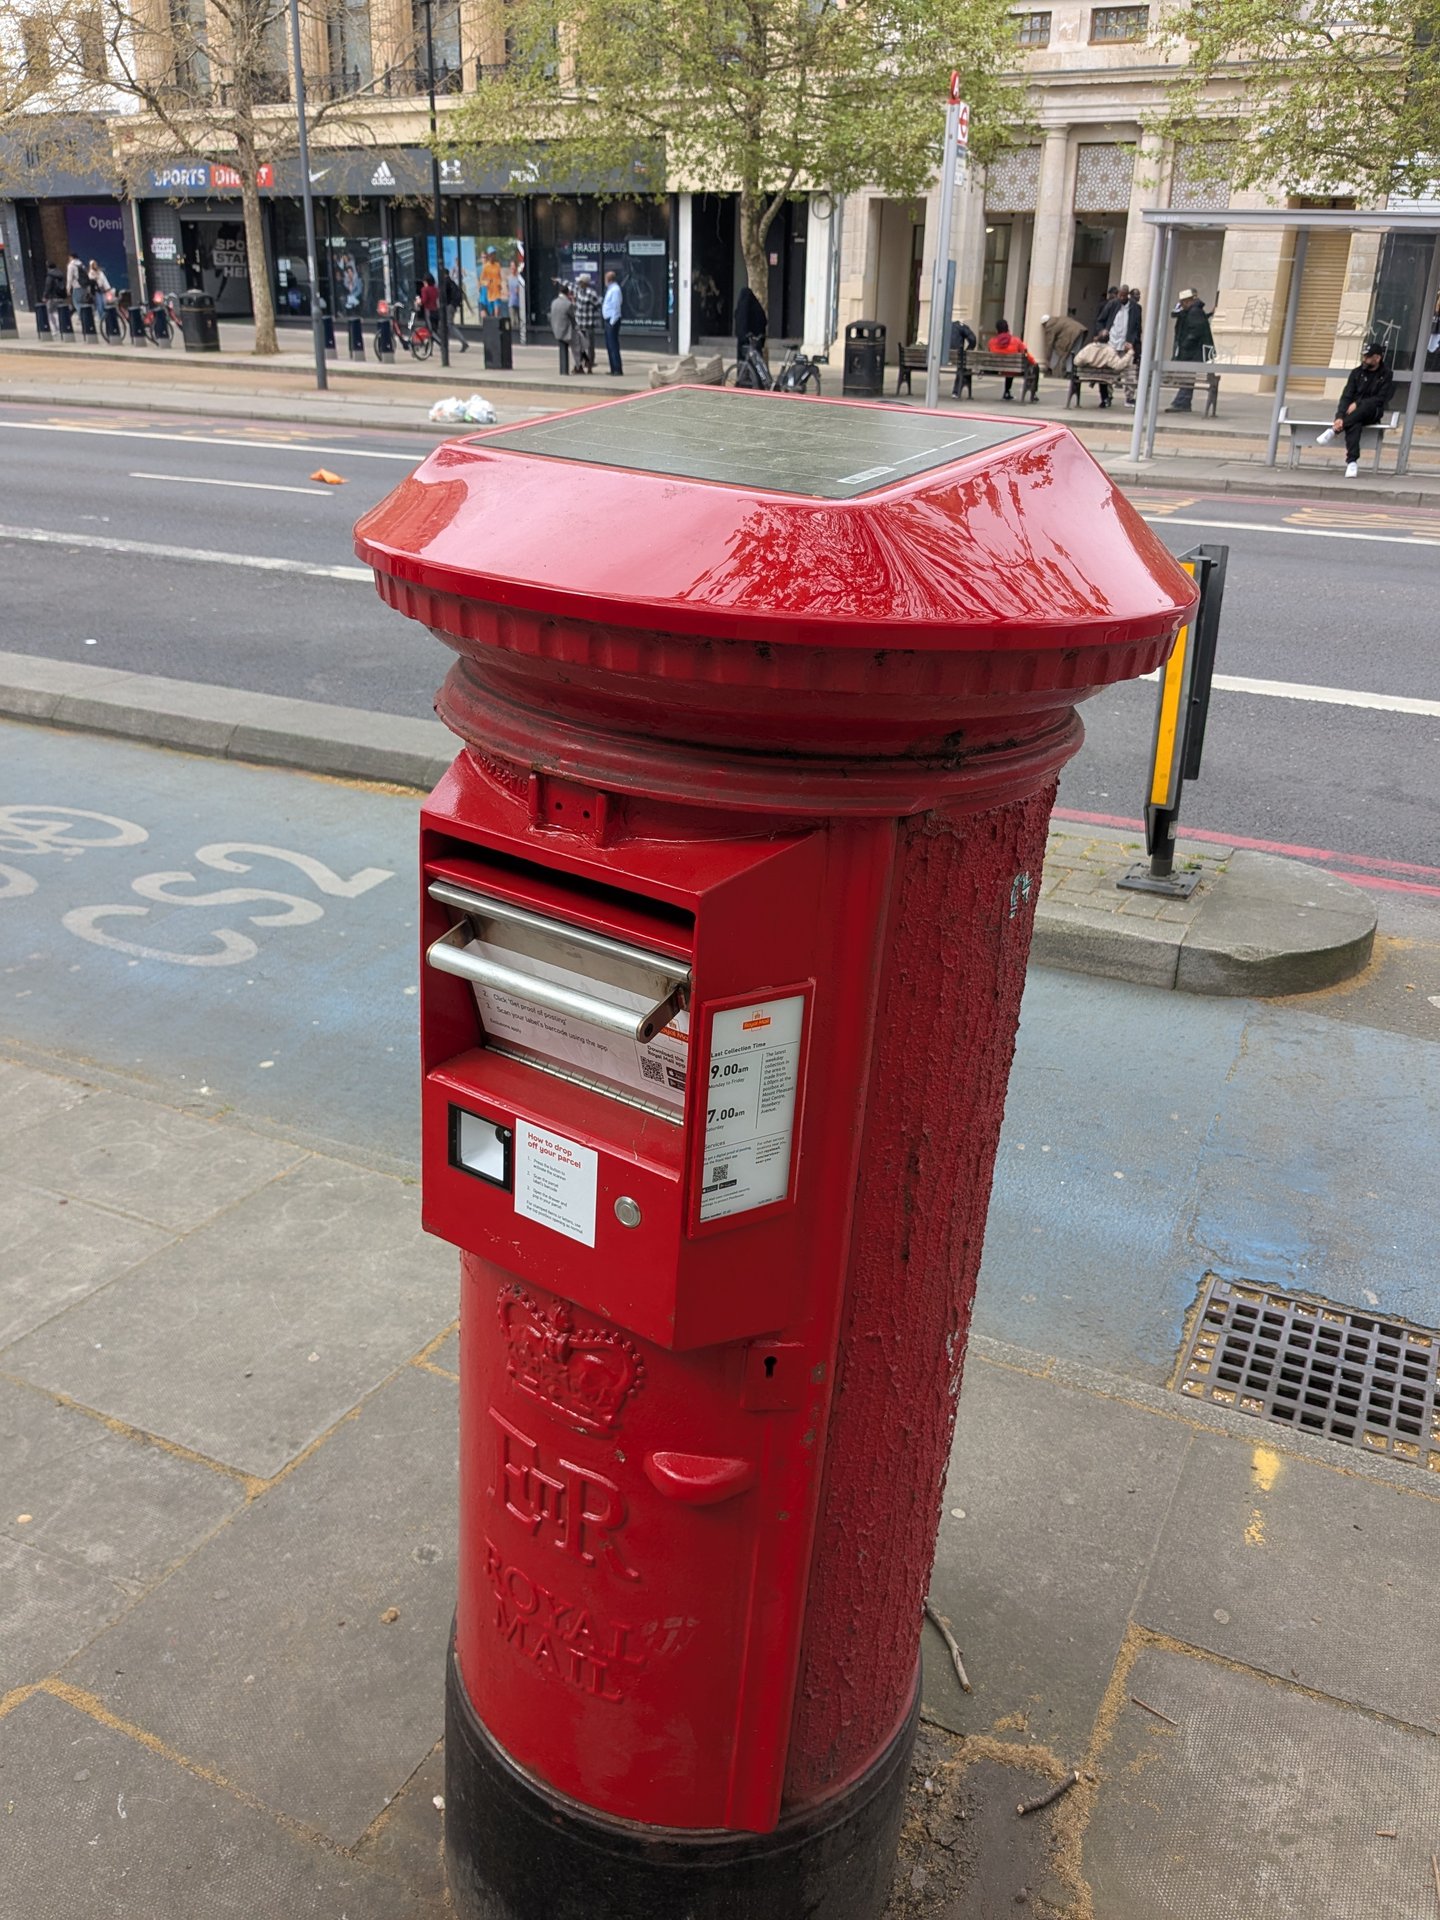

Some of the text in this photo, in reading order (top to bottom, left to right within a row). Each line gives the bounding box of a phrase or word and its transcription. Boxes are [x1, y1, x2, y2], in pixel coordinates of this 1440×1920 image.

[155, 166, 268, 186] SPORTS DIRT
[89, 216, 123, 232] Openi
[215, 239, 245, 251] SPO
[214, 252, 245, 264] STA
[223, 267, 247, 278] HE
[493, 994, 507, 1003] Click
[521, 1003, 536, 1014] proof
[497, 1006, 511, 1016] Scan
[511, 1012, 525, 1021] your
[544, 1023, 568, 1036] barcode
[569, 1032, 585, 1044] using
[586, 1038, 596, 1046] the
[597, 1043, 608, 1052] app
[647, 1045, 684, 1063] Download the
[724, 1045, 751, 1055] Collection
[648, 1050, 686, 1069] Royal Mail app
[764, 1061, 785, 1069] collection
[711, 1063, 749, 1080] 9.00am
[708, 1081, 725, 1089] Monday
[731, 1077, 745, 1085] Friday
[707, 1107, 745, 1124] 7.00am
[528, 1132, 572, 1157] How to drop
[528, 1141, 581, 1169] off your parcel
[483, 1536, 645, 1665] ROYAL
[494, 1591, 624, 1703] MAIL
